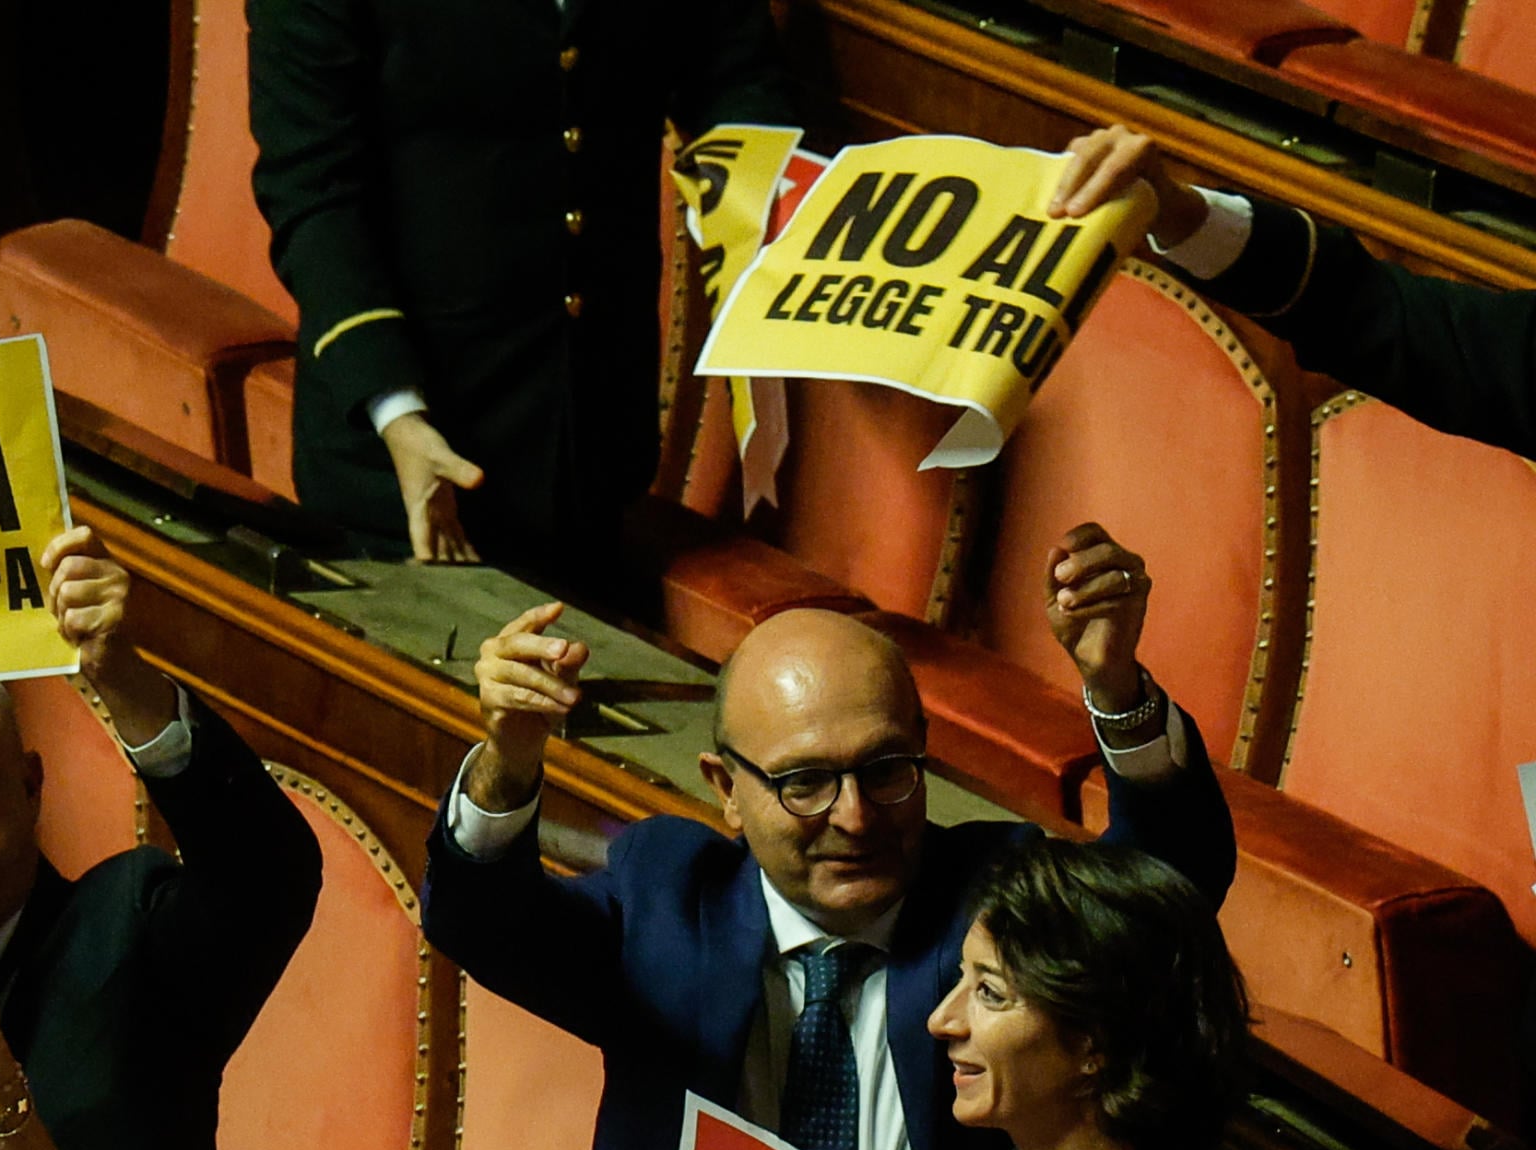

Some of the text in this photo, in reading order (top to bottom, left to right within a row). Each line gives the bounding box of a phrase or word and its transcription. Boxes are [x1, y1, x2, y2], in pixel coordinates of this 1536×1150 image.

[804, 172, 980, 268] NO
[765, 274, 1066, 392] LEGGE TRU
